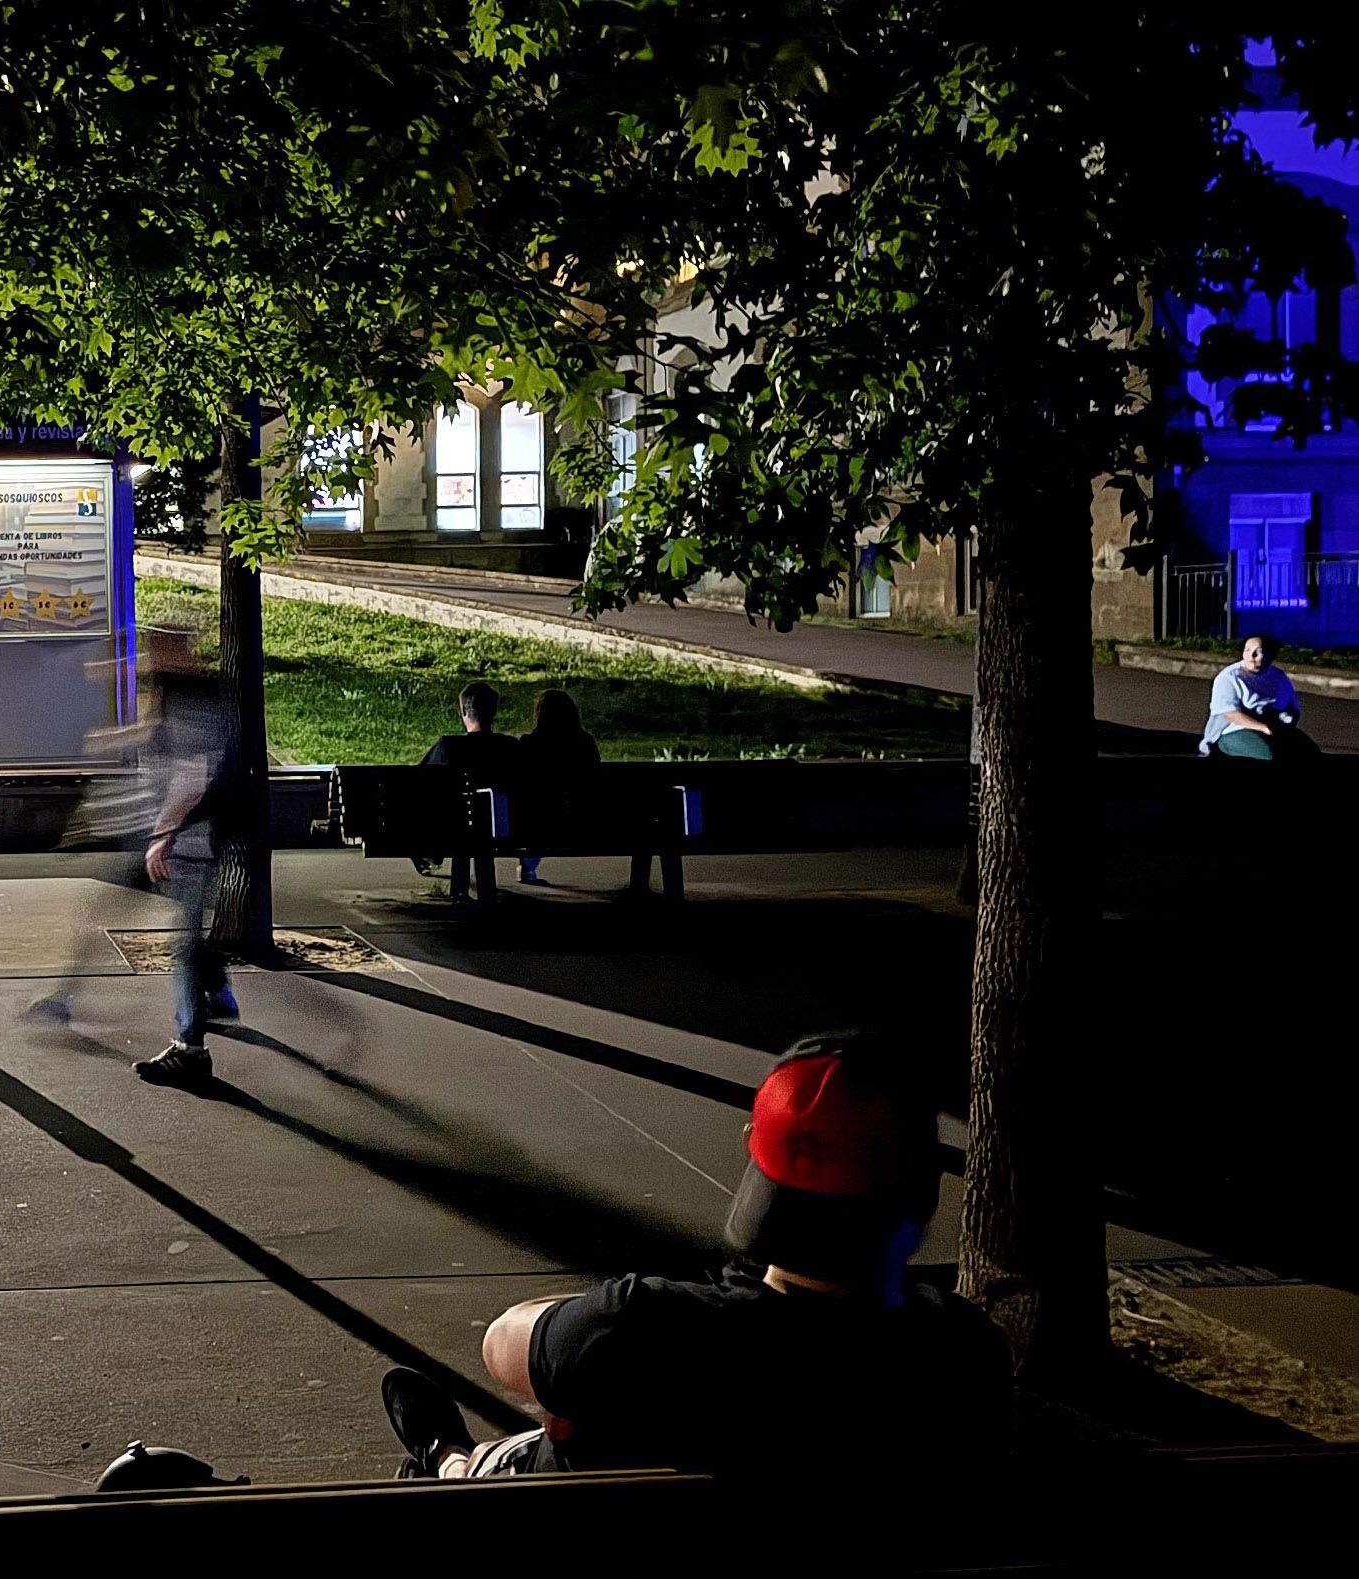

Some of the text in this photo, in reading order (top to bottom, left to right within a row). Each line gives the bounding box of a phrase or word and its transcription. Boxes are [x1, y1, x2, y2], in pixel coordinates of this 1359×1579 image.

[18, 426, 27, 444] y
[23, 532, 33, 540] DE
[35, 532, 62, 540] LIBROS
[17, 542, 39, 550] PARA
[20, 551, 83, 560] OPORTUNIDADES
